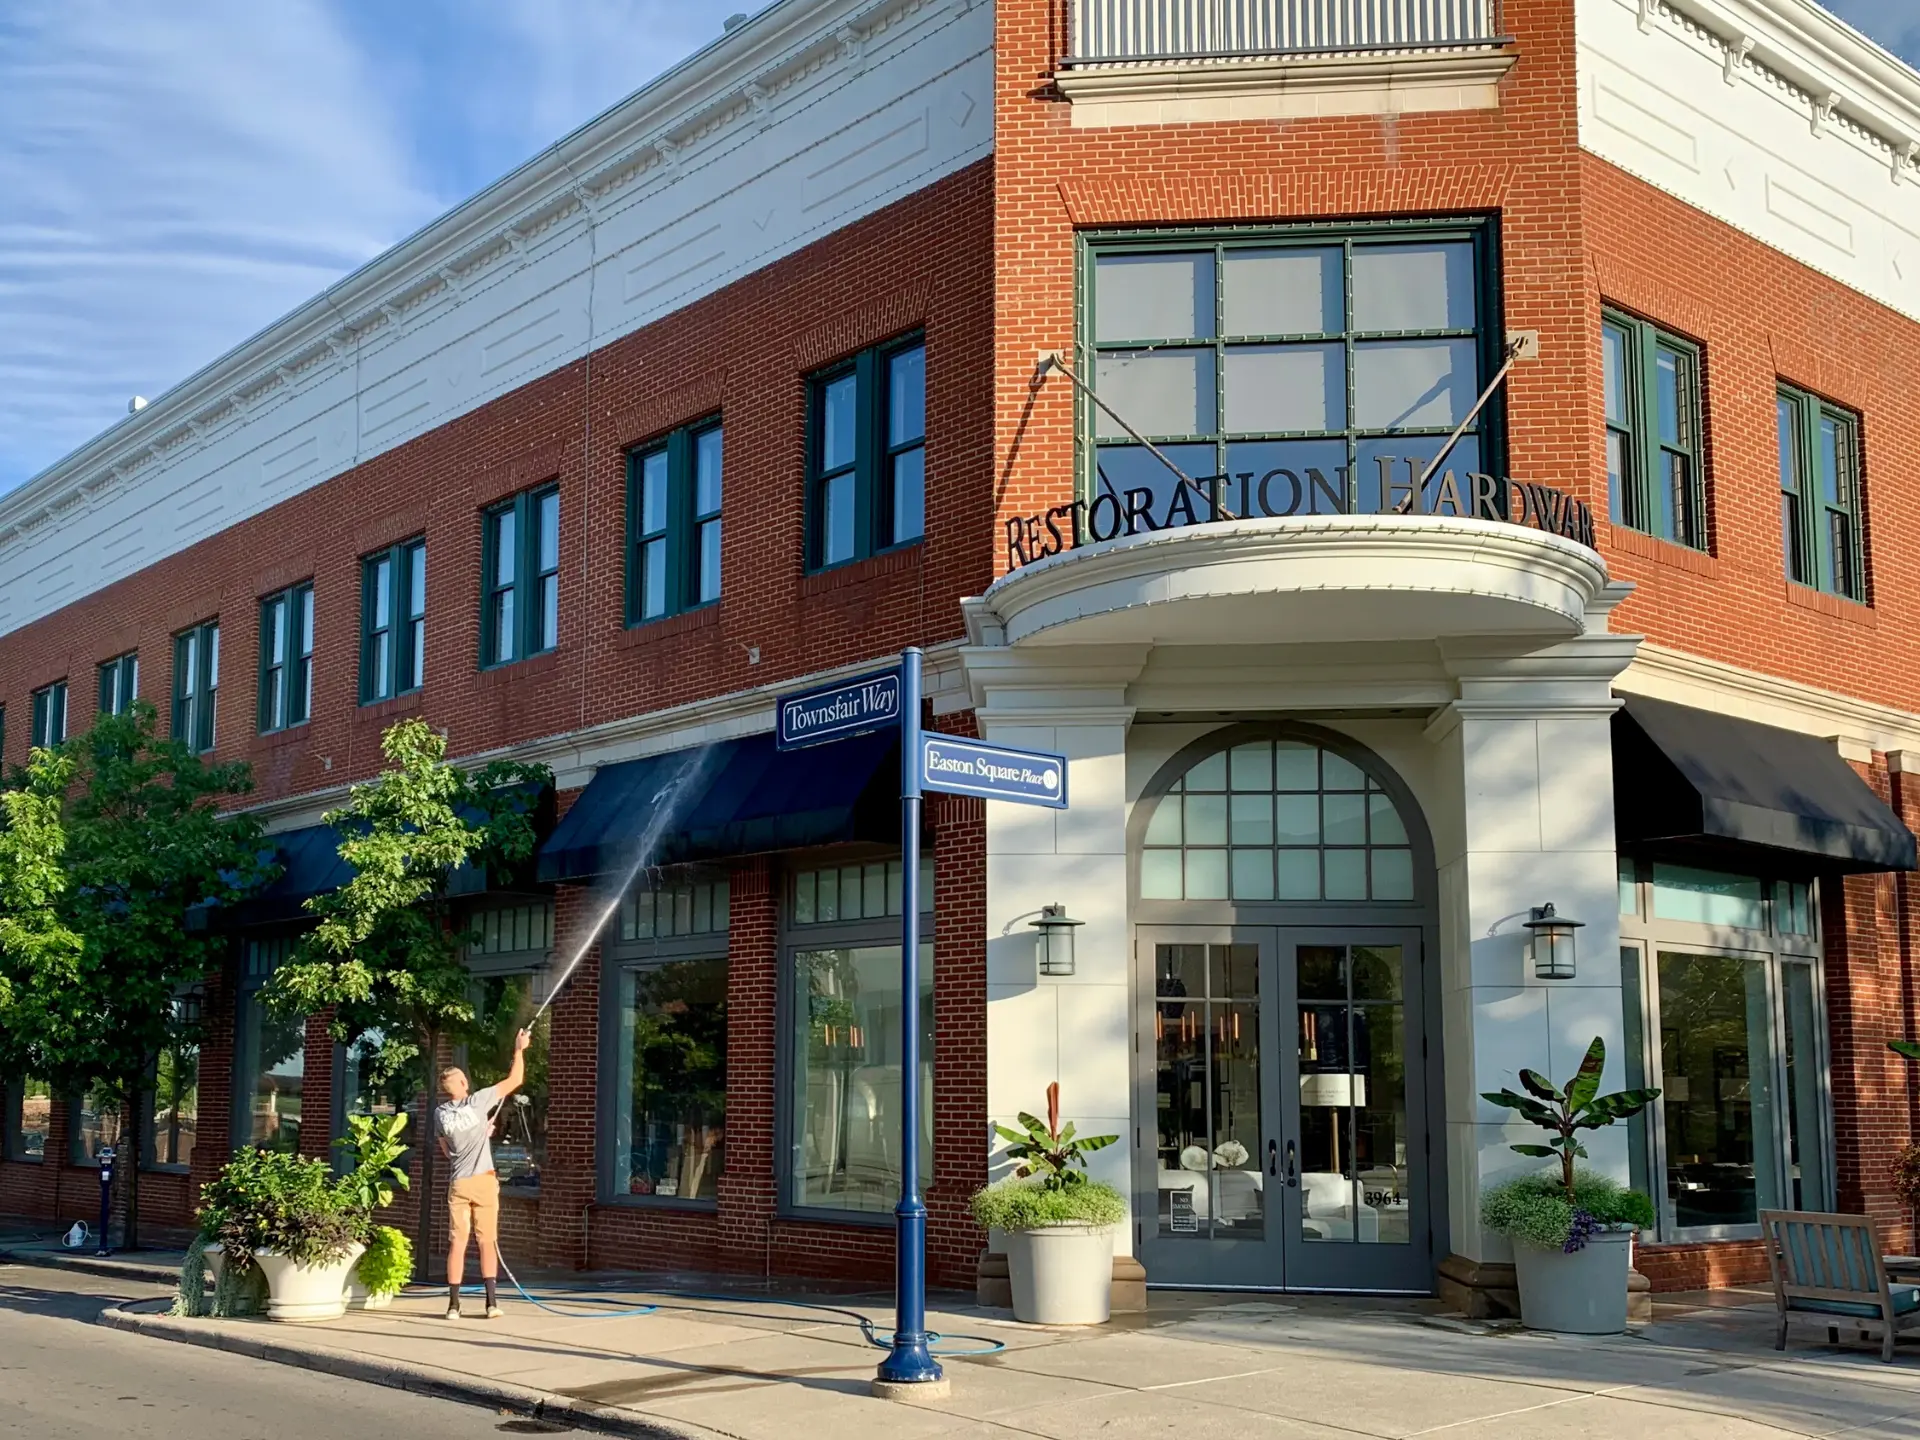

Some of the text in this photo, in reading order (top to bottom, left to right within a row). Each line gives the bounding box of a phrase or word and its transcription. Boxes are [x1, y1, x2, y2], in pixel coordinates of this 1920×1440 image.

[1004, 455, 1598, 574] RESTORATION HARDWAR
[787, 683, 896, 731] Townsfair Way
[929, 750, 1044, 785] Easton Square Place
[1364, 1191, 1402, 1206] 3964
